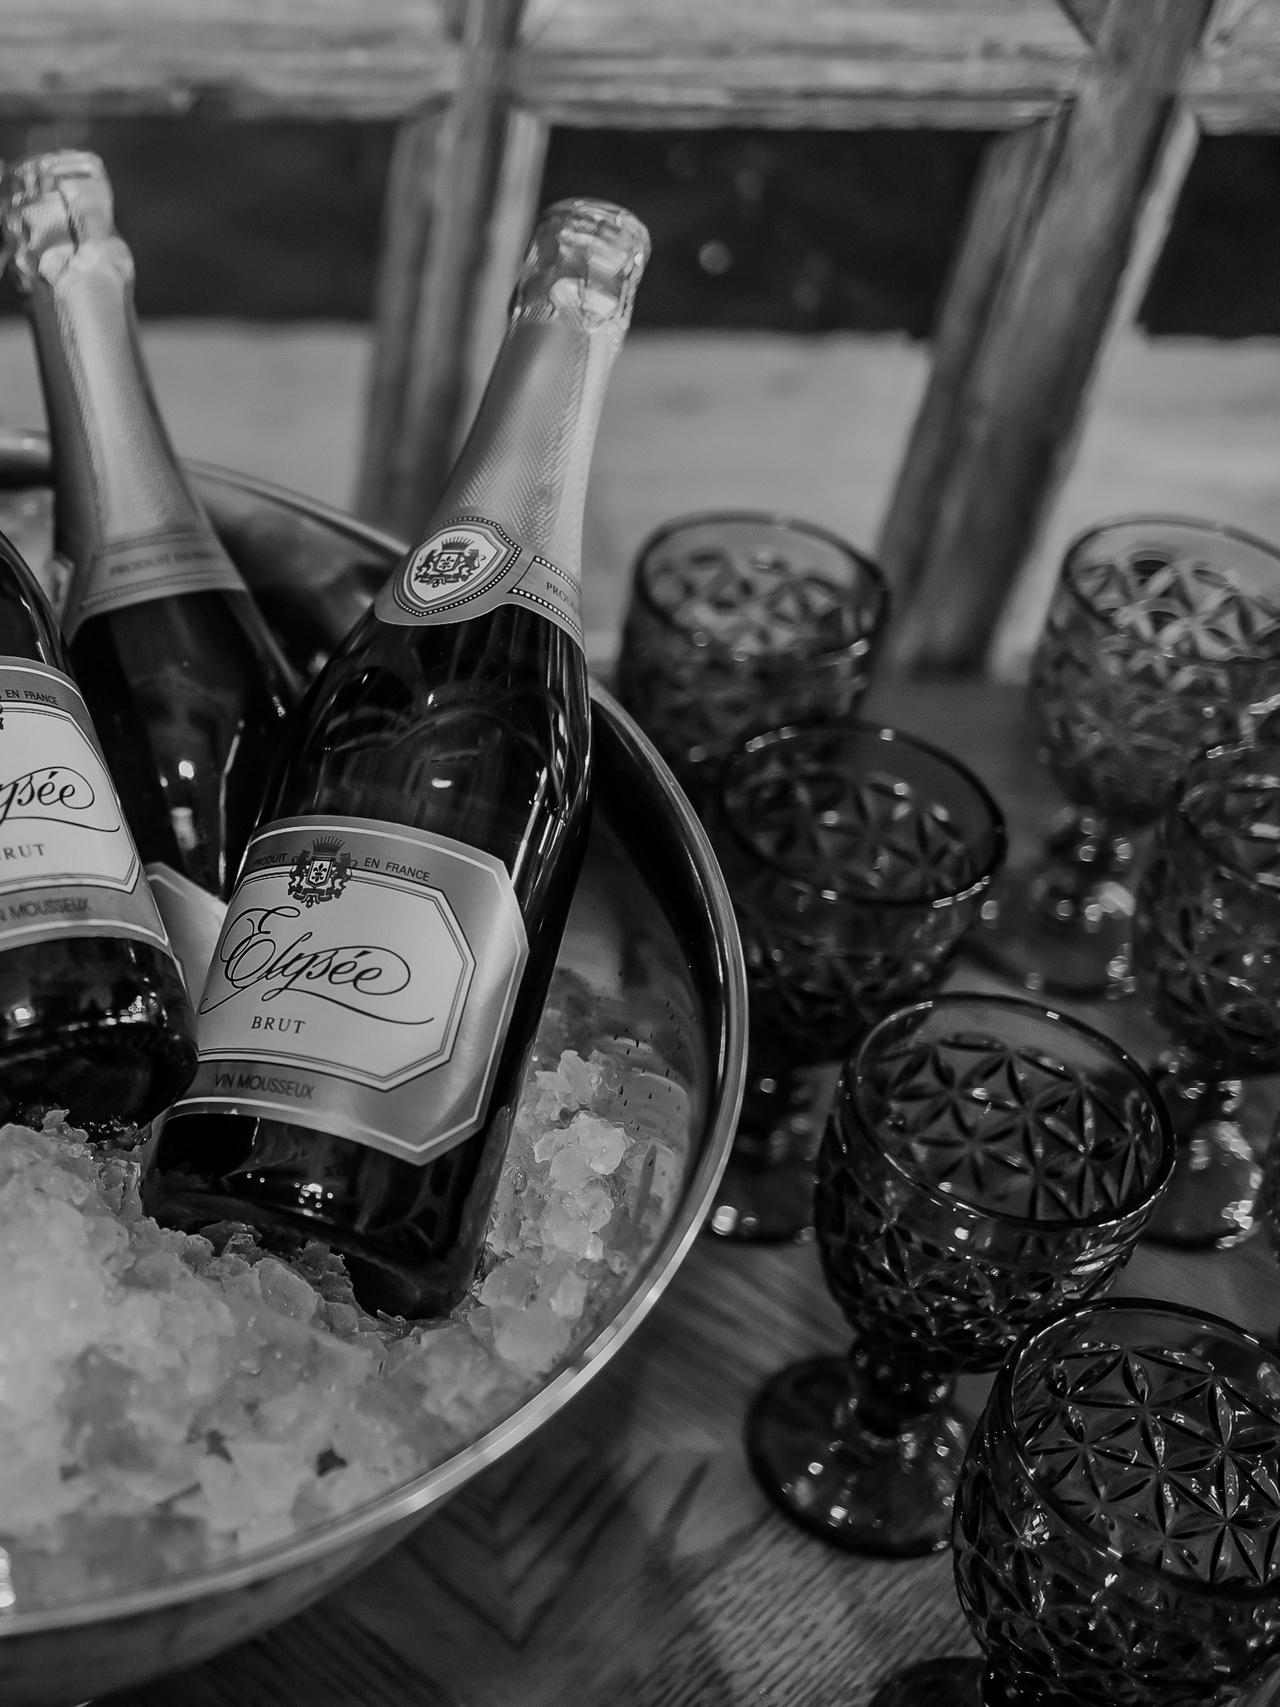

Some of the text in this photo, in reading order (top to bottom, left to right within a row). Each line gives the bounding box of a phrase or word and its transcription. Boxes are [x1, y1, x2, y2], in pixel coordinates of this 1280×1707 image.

[4, 688, 20, 699] EN
[23, 690, 59, 706] FRANCE
[252, 853, 431, 882] PRODUIT EN FRANCE
[8, 897, 92, 918] MOUSSEUX
[199, 906, 435, 1025] Elysée
[251, 1016, 306, 1034] BRUT
[215, 1073, 315, 1099] VIN MOUSSEUX
